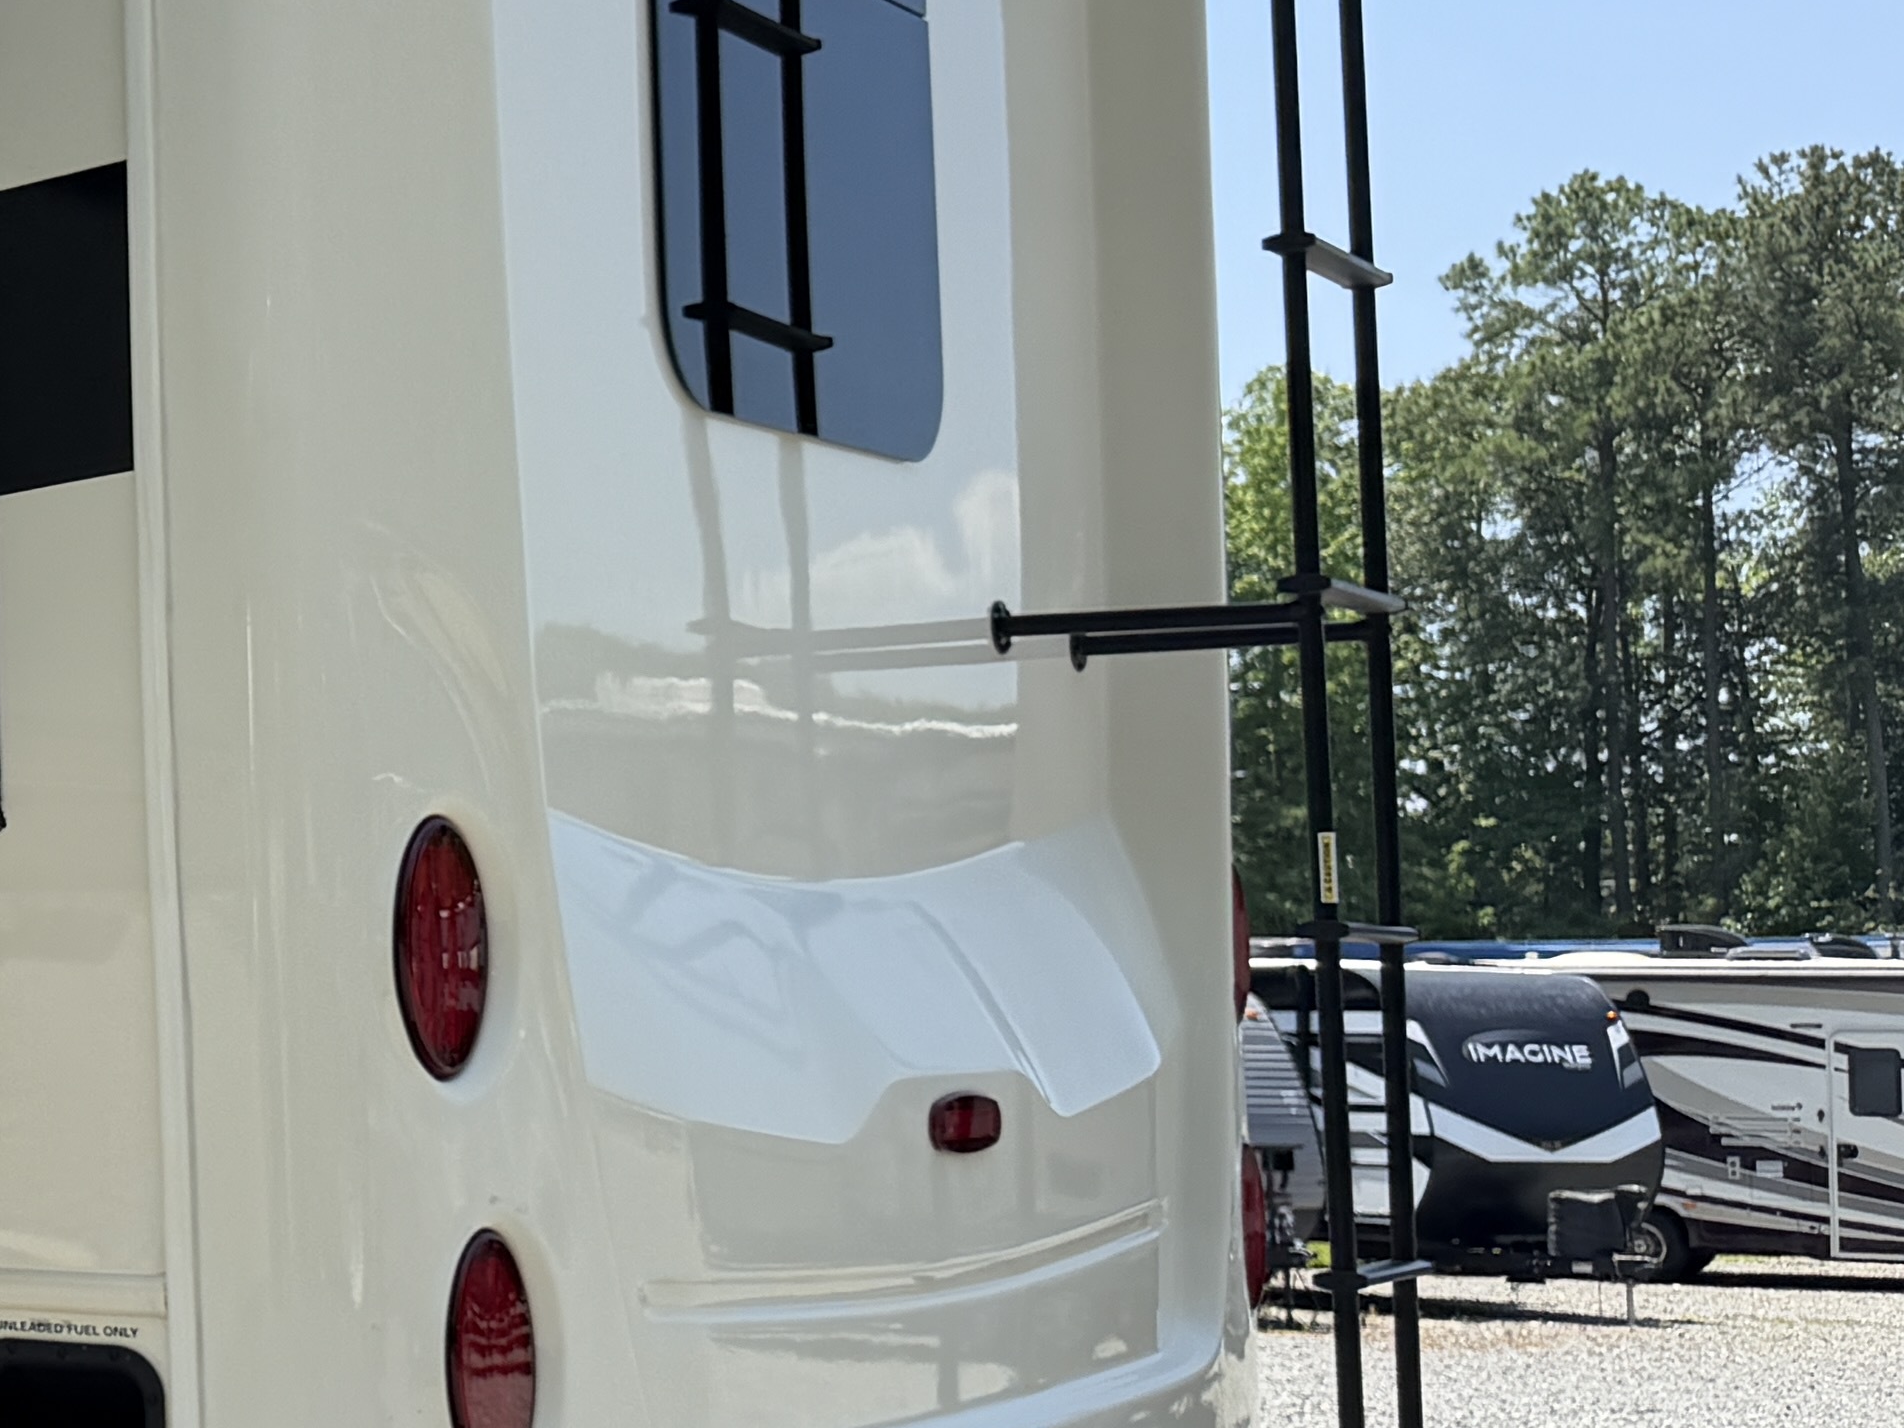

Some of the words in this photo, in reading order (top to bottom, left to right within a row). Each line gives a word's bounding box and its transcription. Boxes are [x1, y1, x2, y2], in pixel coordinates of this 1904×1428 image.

[1467, 1042, 1592, 1064] IMAGINE
[67, 1322, 100, 1336] FUEL
[103, 1325, 138, 1338] ONLY
